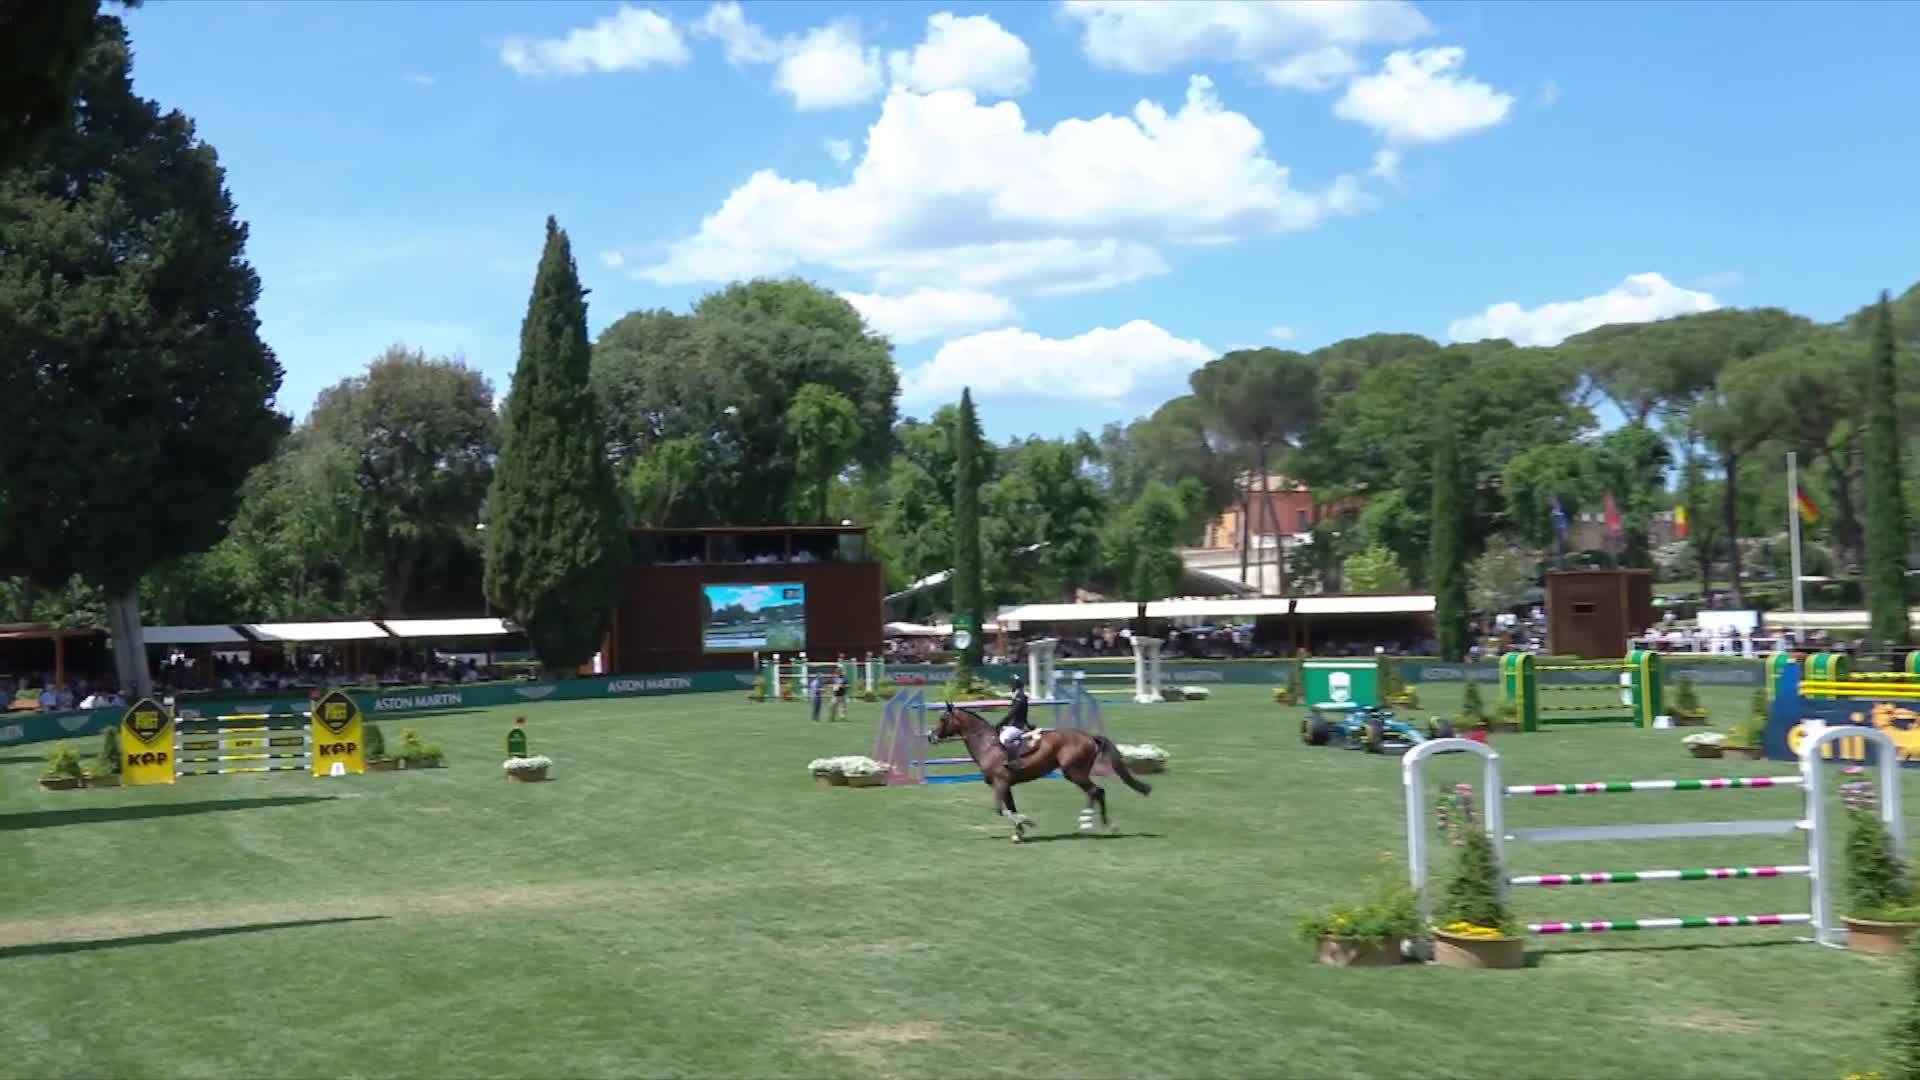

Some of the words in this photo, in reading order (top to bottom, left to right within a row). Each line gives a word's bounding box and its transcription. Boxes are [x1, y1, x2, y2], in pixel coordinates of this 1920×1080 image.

[608, 679, 644, 692] ASTON
[646, 677, 691, 689] MARTIN
[374, 696, 413, 711] ASTON
[414, 692, 463, 708] MARTIN
